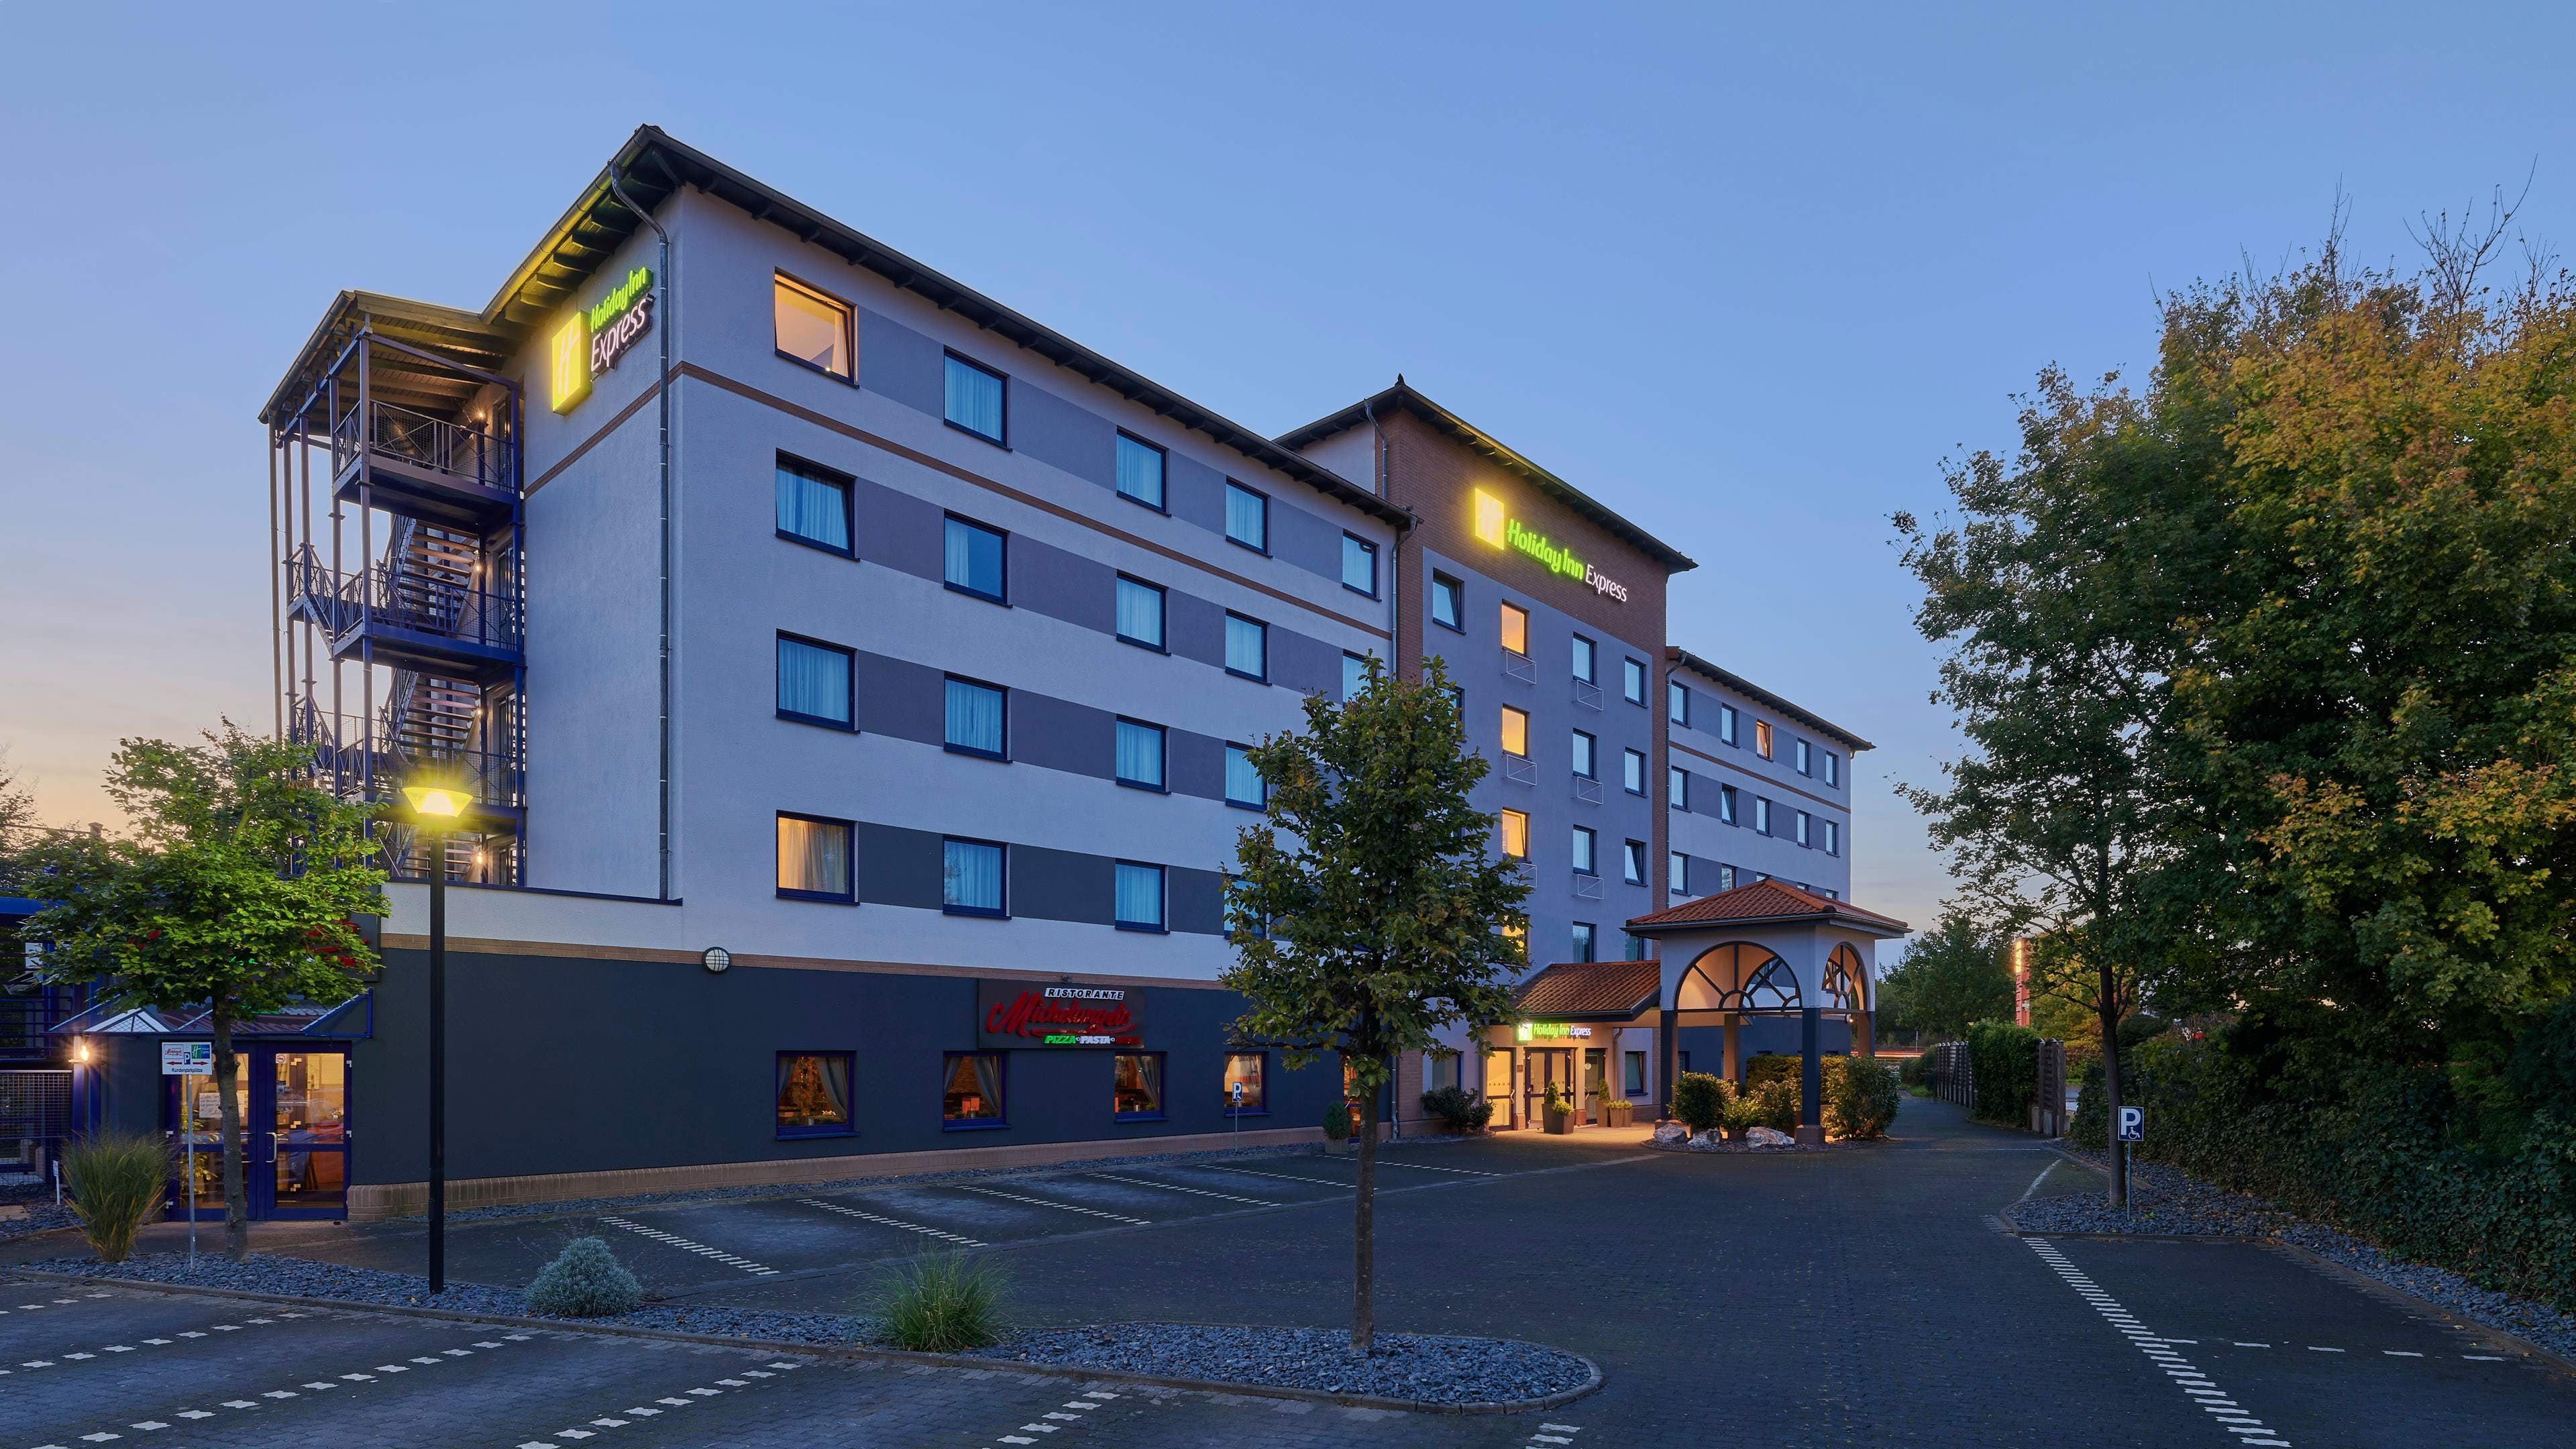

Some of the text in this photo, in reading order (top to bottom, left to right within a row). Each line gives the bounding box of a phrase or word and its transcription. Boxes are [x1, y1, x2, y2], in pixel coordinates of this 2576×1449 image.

[590, 267, 648, 333] Holiday Inn
[591, 297, 647, 372] Express
[1507, 519, 1628, 603] Holiday Inn Express
[1046, 988, 1124, 1000] RISTORANTE
[987, 991, 1133, 1037] Michelangelo
[1044, 1035, 1076, 1044] PIZZA
[1080, 1036, 1111, 1044] PASTA
[1534, 1023, 1592, 1038] Holiday Inn Express
[184, 1053, 191, 1064] P
[1233, 1082, 1242, 1099] P
[2121, 1108, 2141, 1135] P
